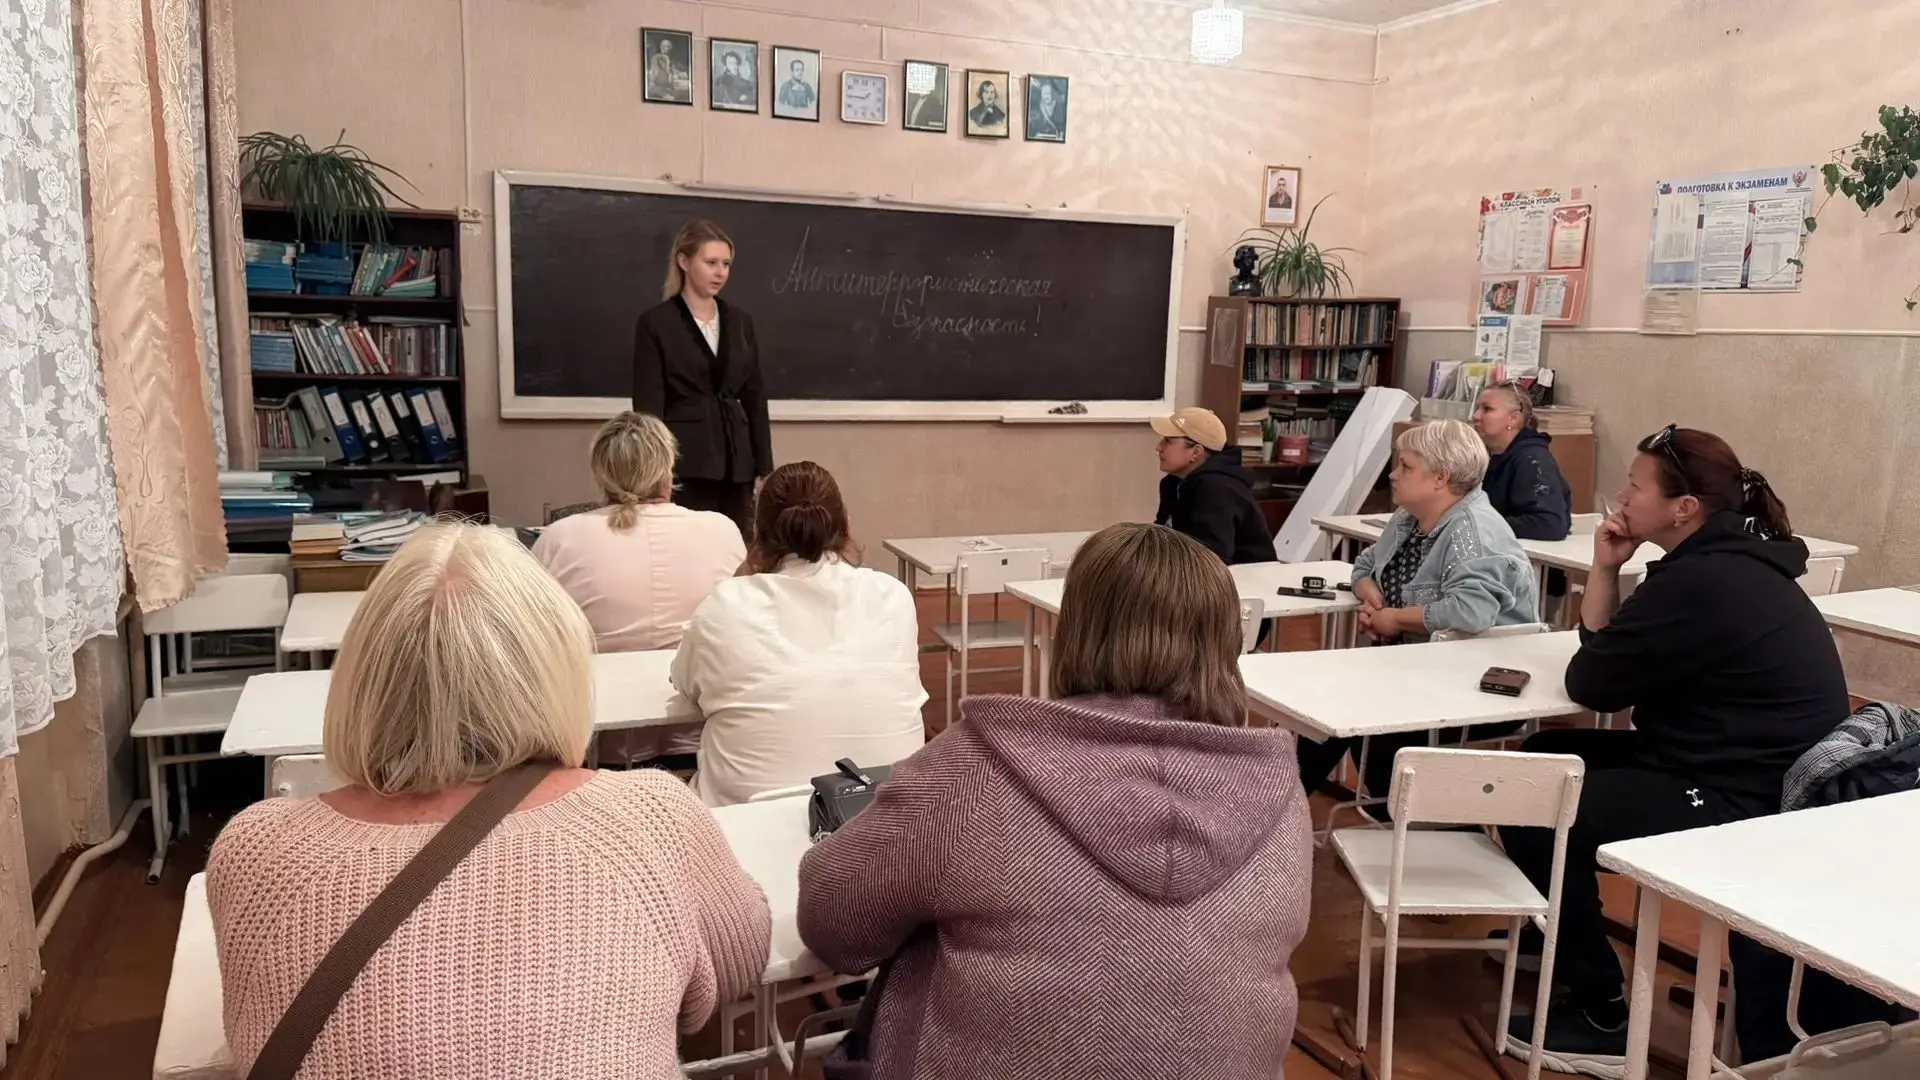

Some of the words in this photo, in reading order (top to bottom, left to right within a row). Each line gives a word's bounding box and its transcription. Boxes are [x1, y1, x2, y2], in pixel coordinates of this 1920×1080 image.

[1728, 183, 1734, 191] К
[1736, 177, 1788, 189] ЭКЗАМЕНАМ
[1500, 198, 1535, 207] КЛАССНЫЙ
[1536, 196, 1560, 205] УГОЛОК
